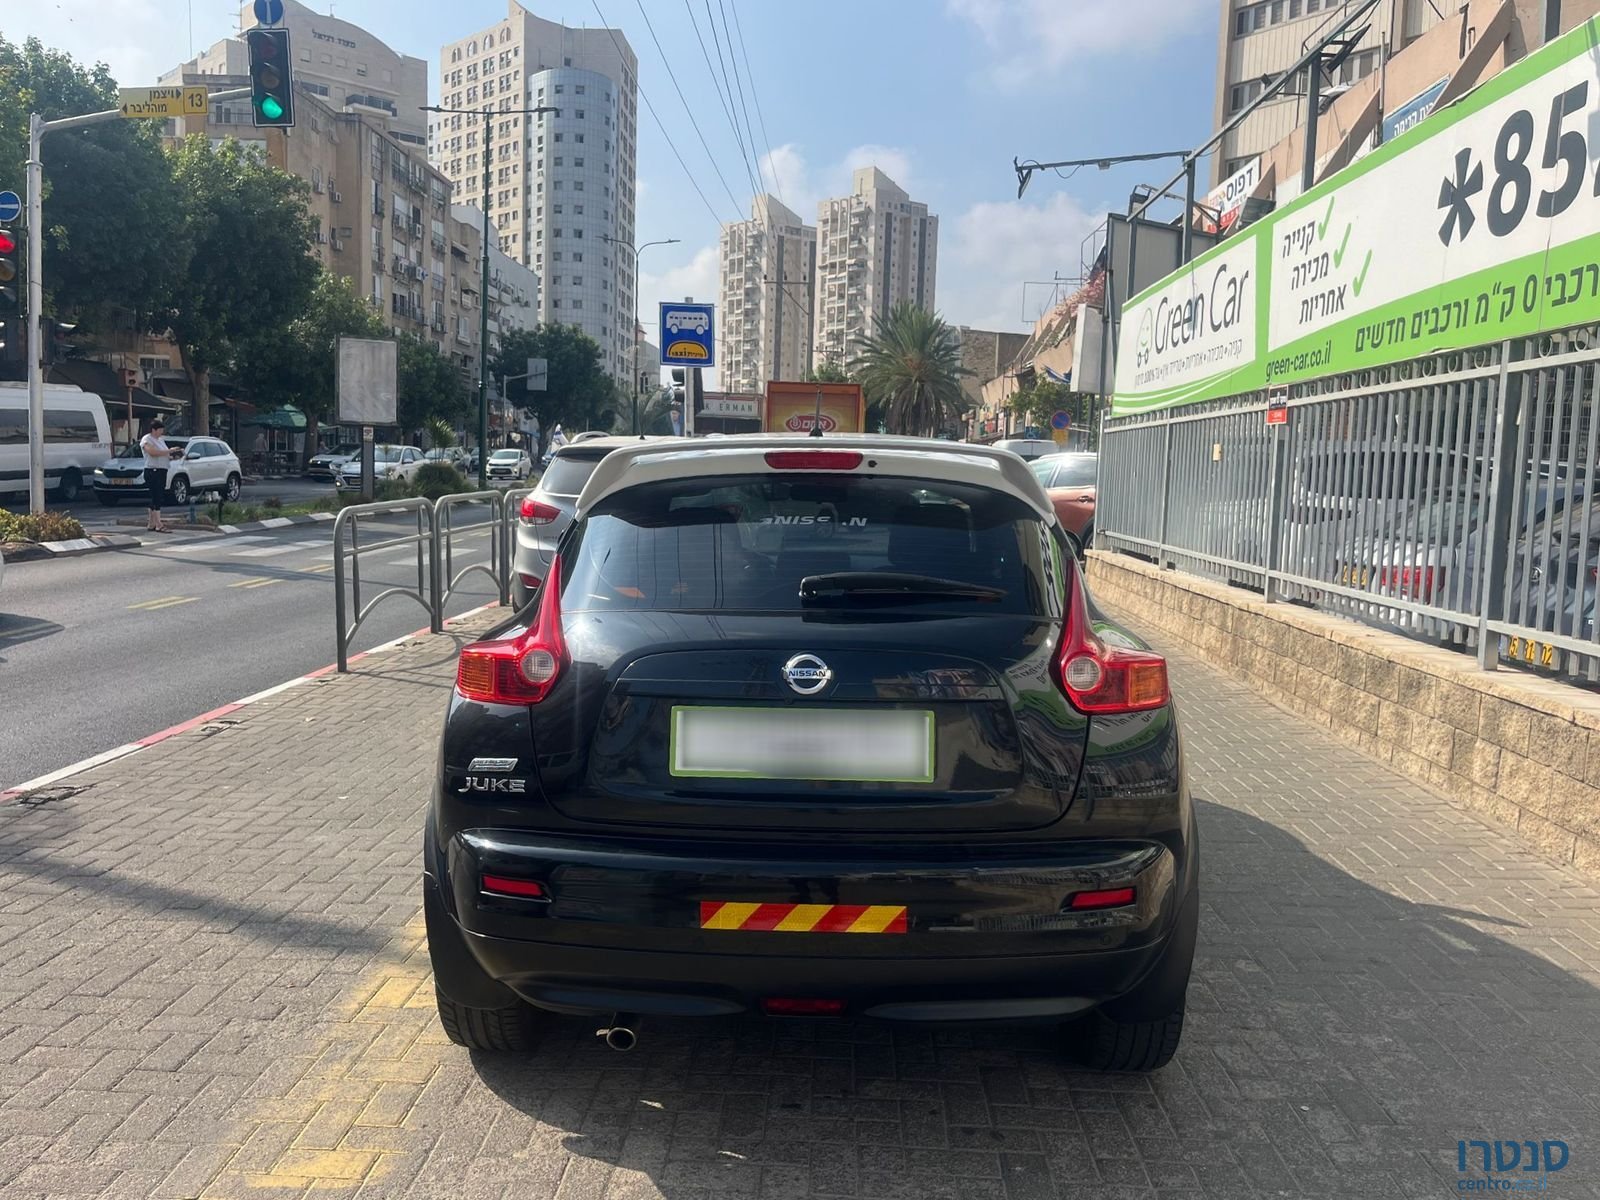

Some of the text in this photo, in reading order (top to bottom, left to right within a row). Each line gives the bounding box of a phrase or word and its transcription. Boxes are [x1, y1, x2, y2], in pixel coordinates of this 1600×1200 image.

[130, 101, 168, 113] מוהליבר
[149, 89, 174, 101] ויצמן
[188, 93, 203, 108] 13
[1438, 80, 1600, 248] 85
[1226, 167, 1253, 202] דפוס
[1282, 220, 1316, 259] קנייה
[1291, 251, 1329, 290] מכירה
[1545, 263, 1600, 308] רכבי
[1155, 263, 1249, 354] Green Car
[1299, 283, 1347, 325] אחריות
[1522, 273, 1538, 314] 0
[1355, 316, 1406, 353] חדשים
[1410, 298, 1470, 340] ורכבים
[1265, 340, 1332, 382] green-car.co.il
[458, 776, 526, 793] JUKE
